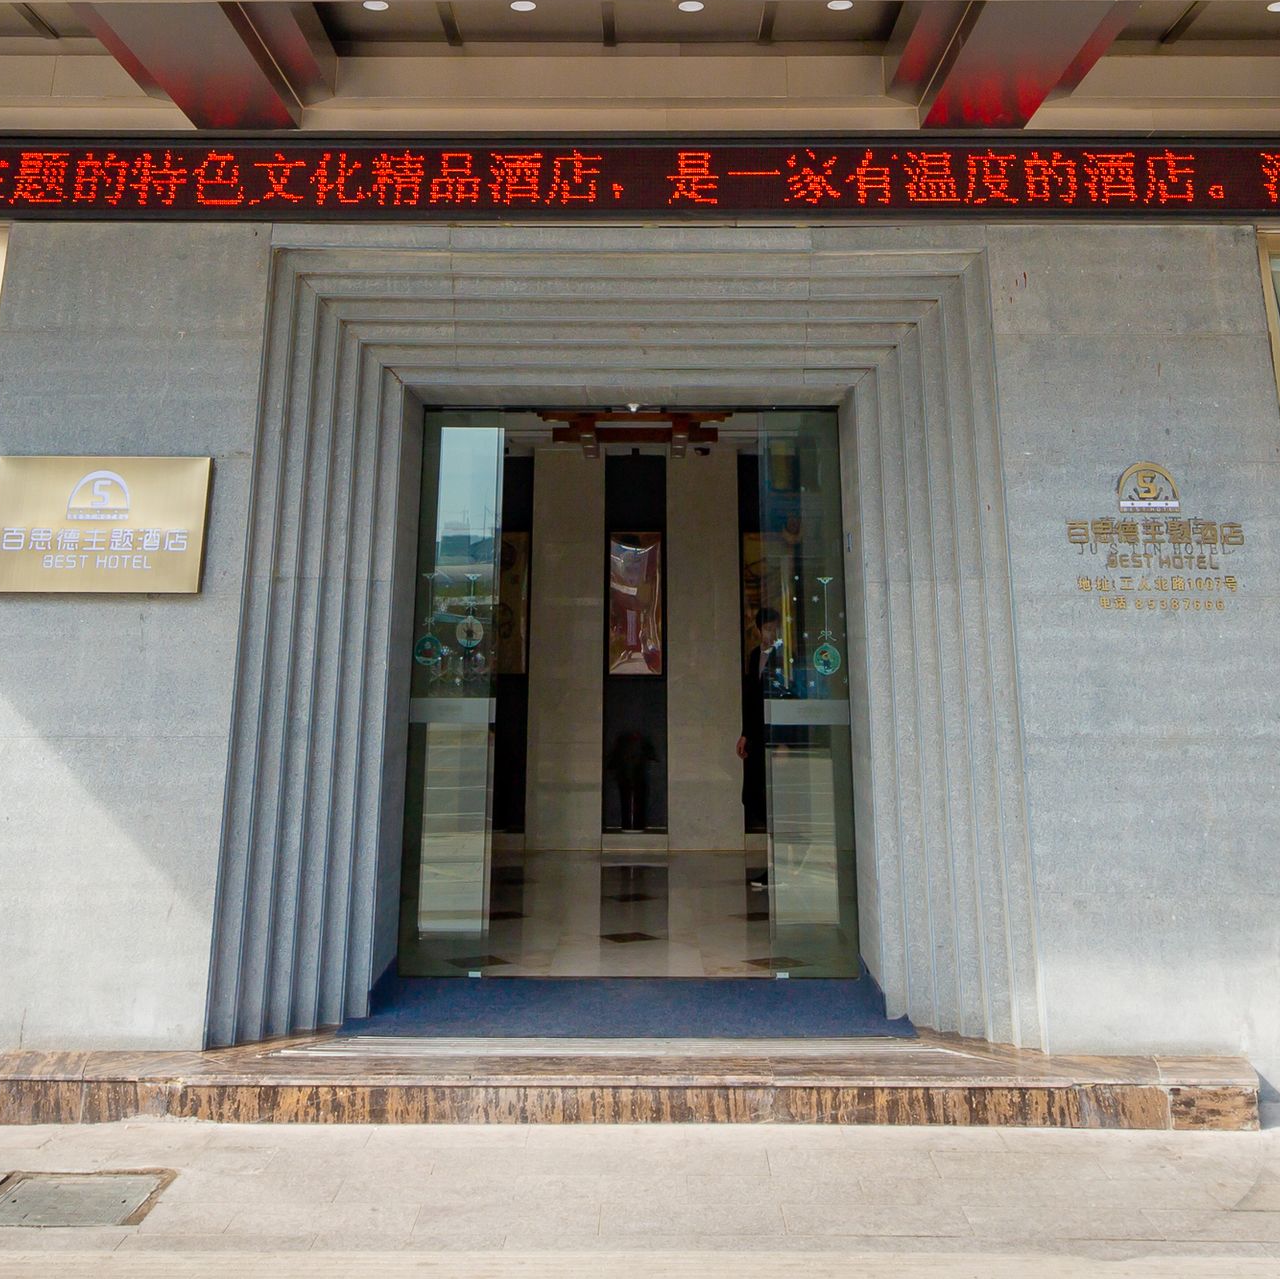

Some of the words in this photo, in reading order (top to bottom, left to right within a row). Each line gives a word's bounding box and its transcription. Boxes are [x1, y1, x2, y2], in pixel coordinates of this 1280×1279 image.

[1, 527, 189, 551] 百思德主题酒店
[1067, 520, 1245, 546] 百思德主题酒店
[42, 555, 88, 569] BEST
[96, 555, 152, 569] HOTEL
[1107, 553, 1154, 569] BEST
[1159, 554, 1221, 570] HOTEL
[1099, 596, 1128, 610] 电话
